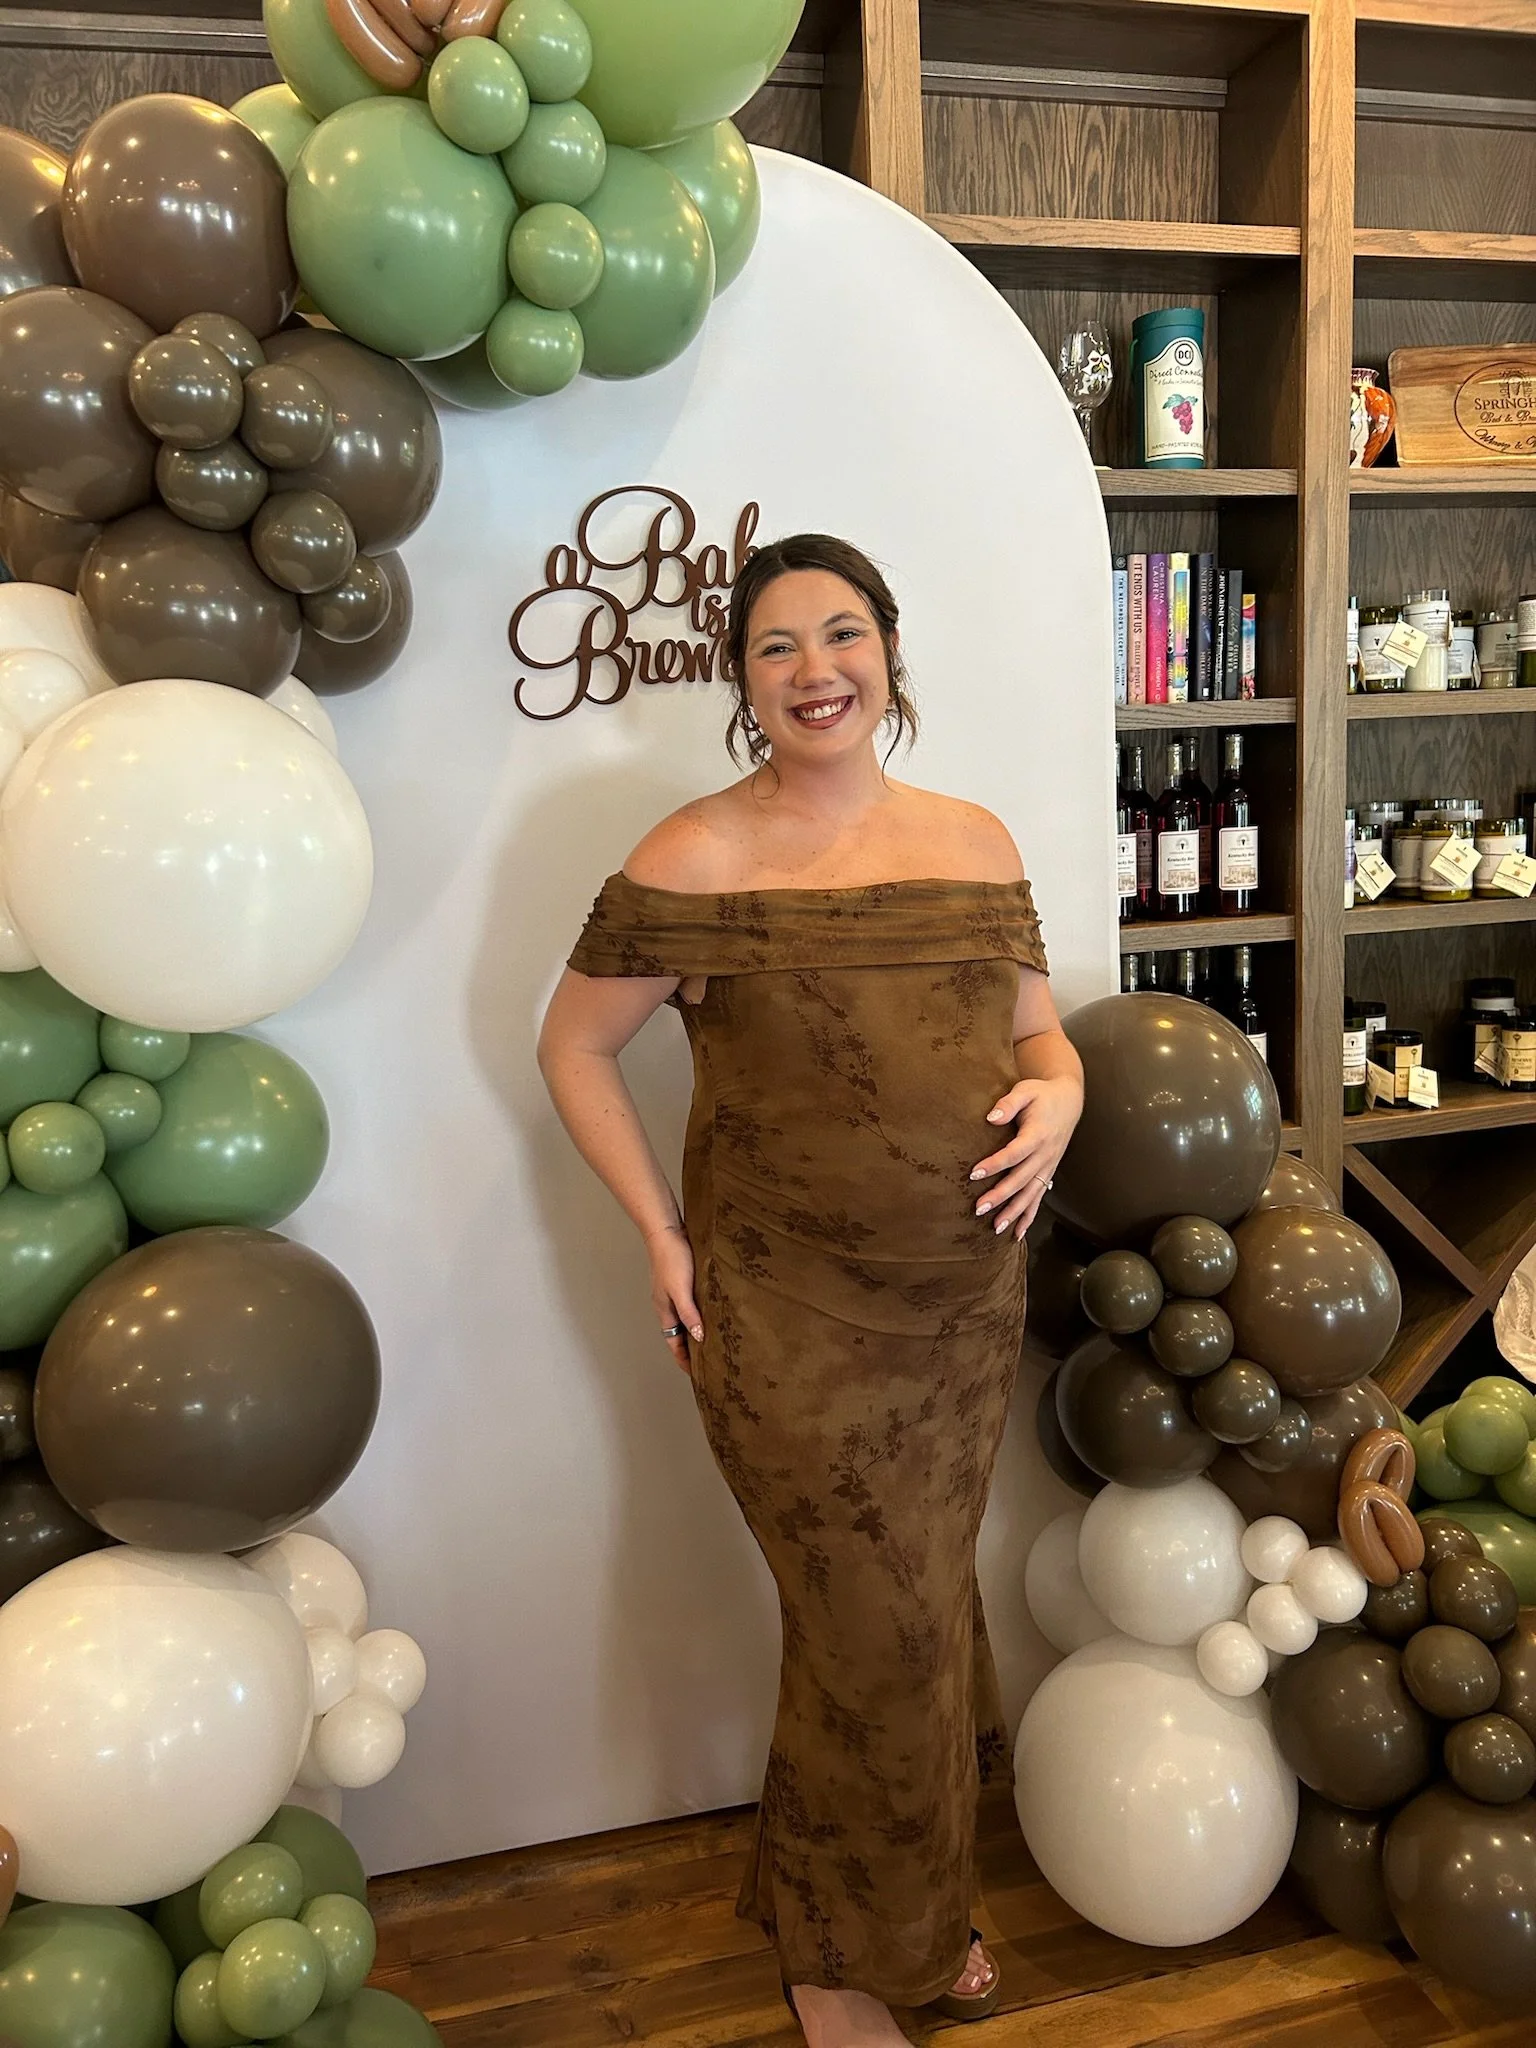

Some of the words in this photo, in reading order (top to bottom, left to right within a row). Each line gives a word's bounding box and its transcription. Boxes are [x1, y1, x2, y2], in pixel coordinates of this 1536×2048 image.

[1149, 368, 1173, 379] Direct
[1474, 398, 1536, 411] SPRINGH
[1480, 411, 1502, 423] Bed
[1505, 414, 1513, 422] &
[1474, 428, 1511, 451] Winery
[1514, 441, 1523, 450] &
[546, 544, 592, 587] a
[577, 485, 760, 615] Bab
[1134, 573, 1142, 596] ENDS
[691, 589, 732, 638] is
[1134, 597, 1142, 620] WITH
[1134, 622, 1142, 634] US
